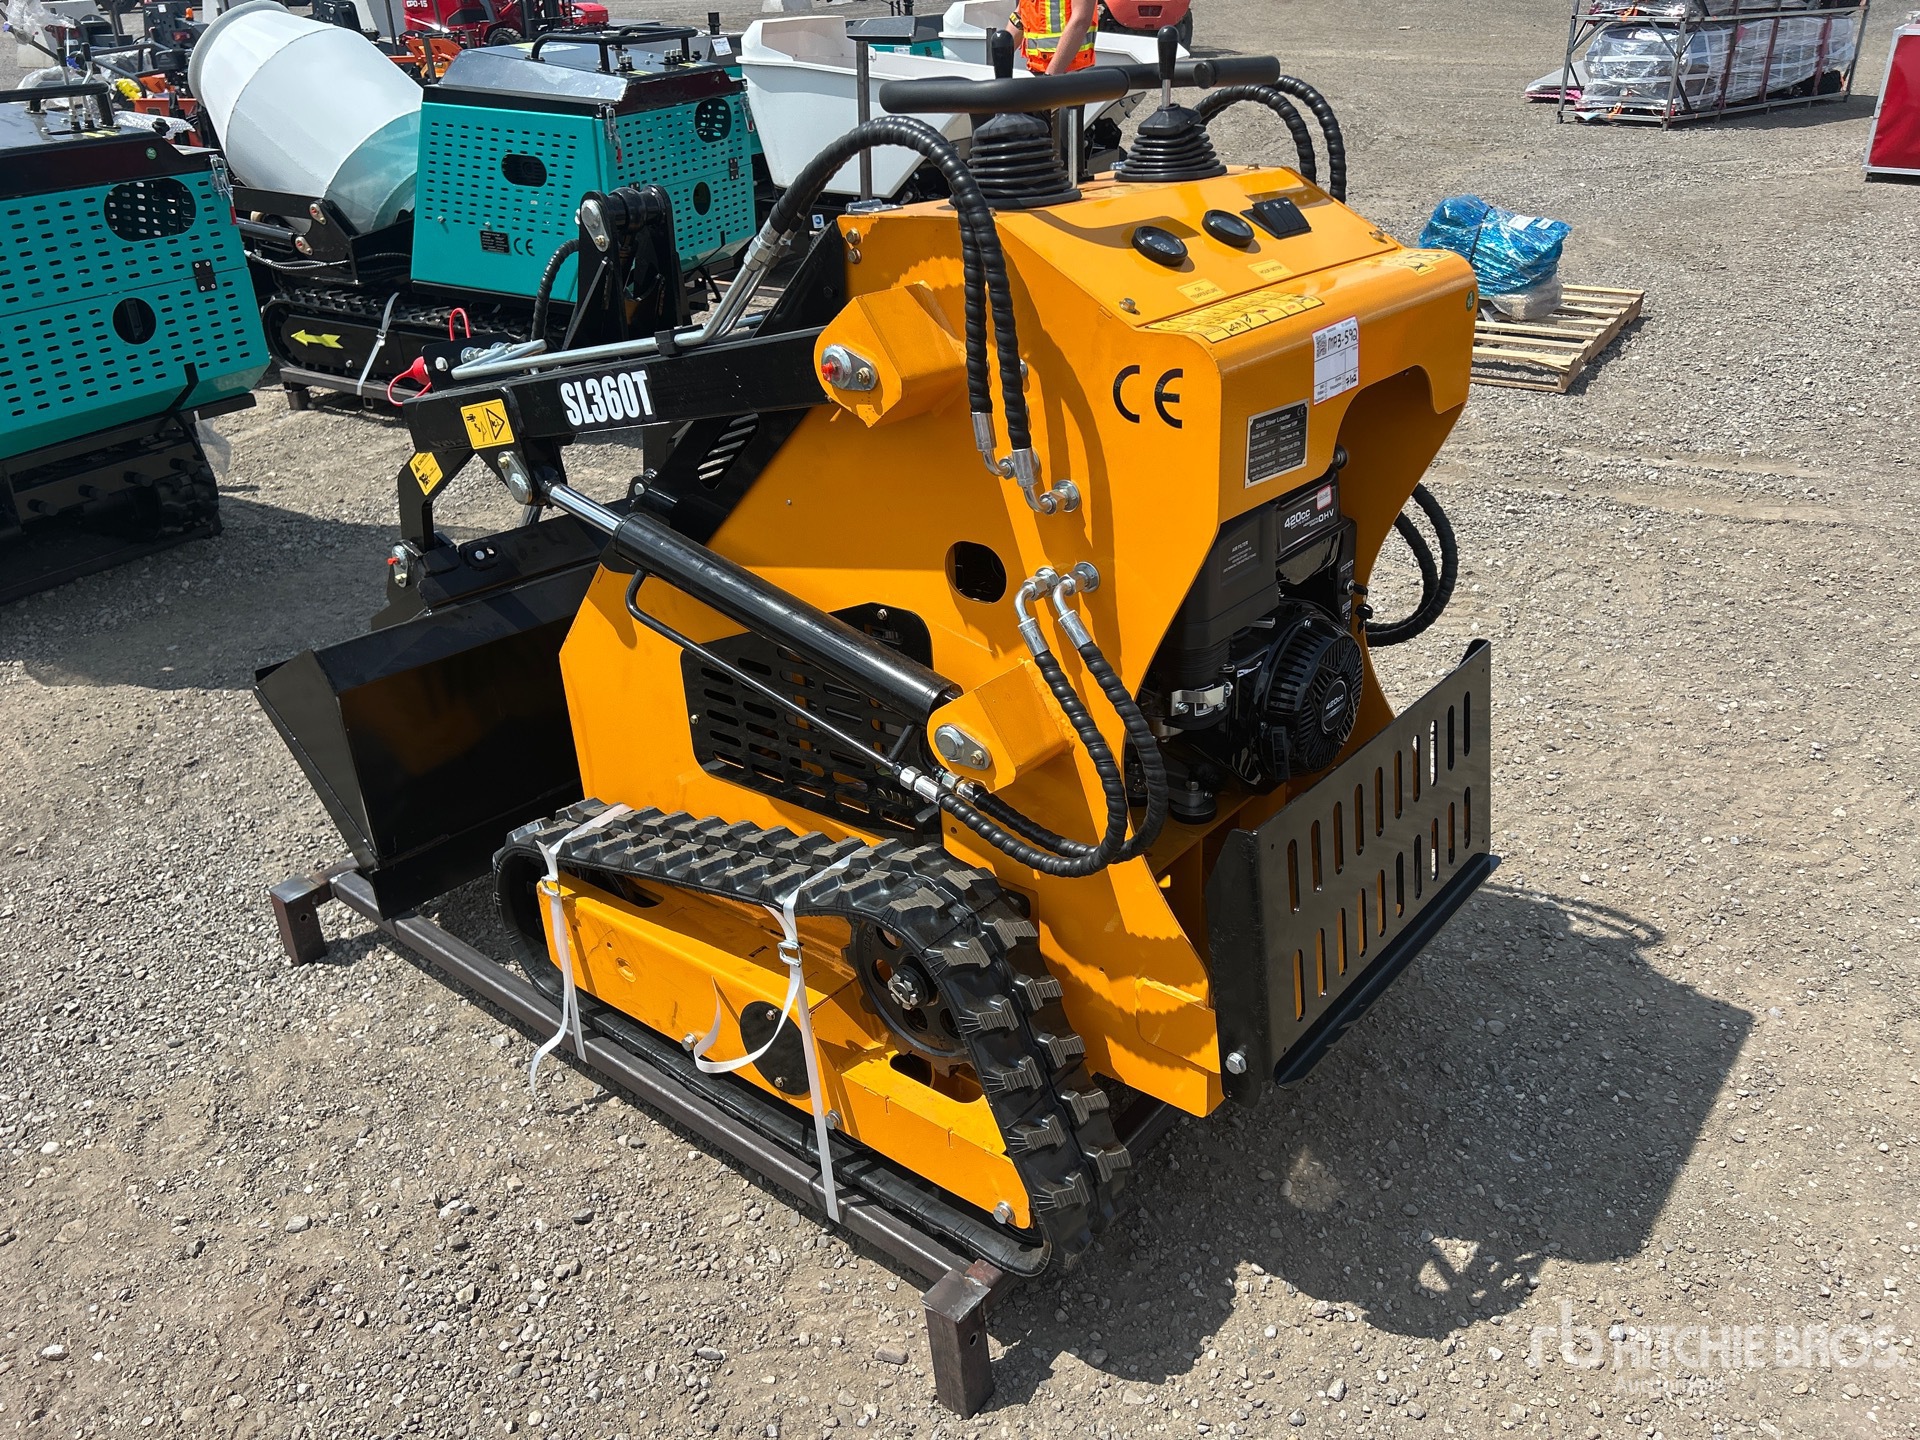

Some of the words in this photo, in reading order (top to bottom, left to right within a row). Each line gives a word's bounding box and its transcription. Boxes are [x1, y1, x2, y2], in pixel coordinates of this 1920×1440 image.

[560, 370, 653, 426] SL360T
[1112, 364, 1184, 429] CE
[1276, 413, 1292, 423] Loader
[1284, 509, 1311, 528] 420cc
[1318, 508, 1334, 523] OHV
[1326, 693, 1344, 710] 420cc
